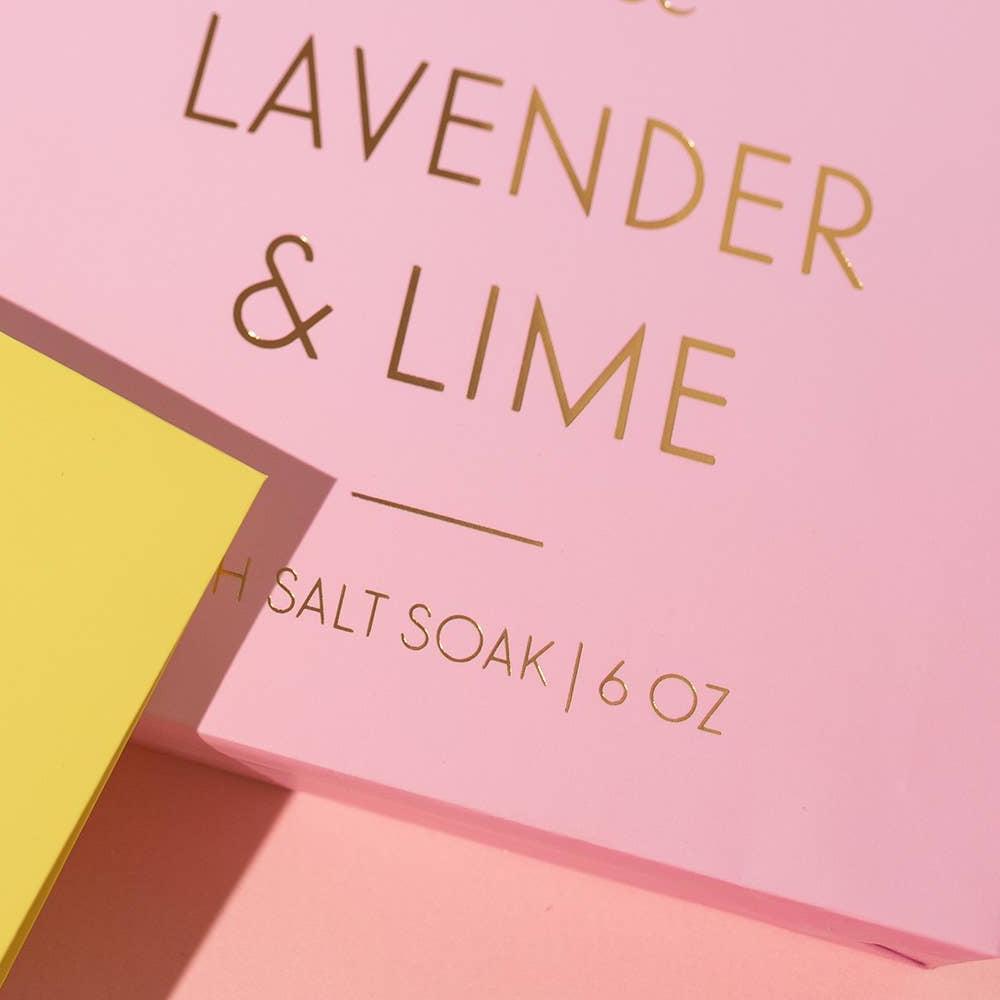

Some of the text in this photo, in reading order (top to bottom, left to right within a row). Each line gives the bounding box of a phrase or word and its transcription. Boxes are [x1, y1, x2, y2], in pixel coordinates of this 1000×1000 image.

[184, 12, 875, 291] LAVENDER
[233, 234, 736, 466] & LIME
[267, 566, 391, 637] SALT
[401, 603, 555, 687] SOAK
[598, 660, 629, 706] 6
[649, 672, 731, 736] OZ
